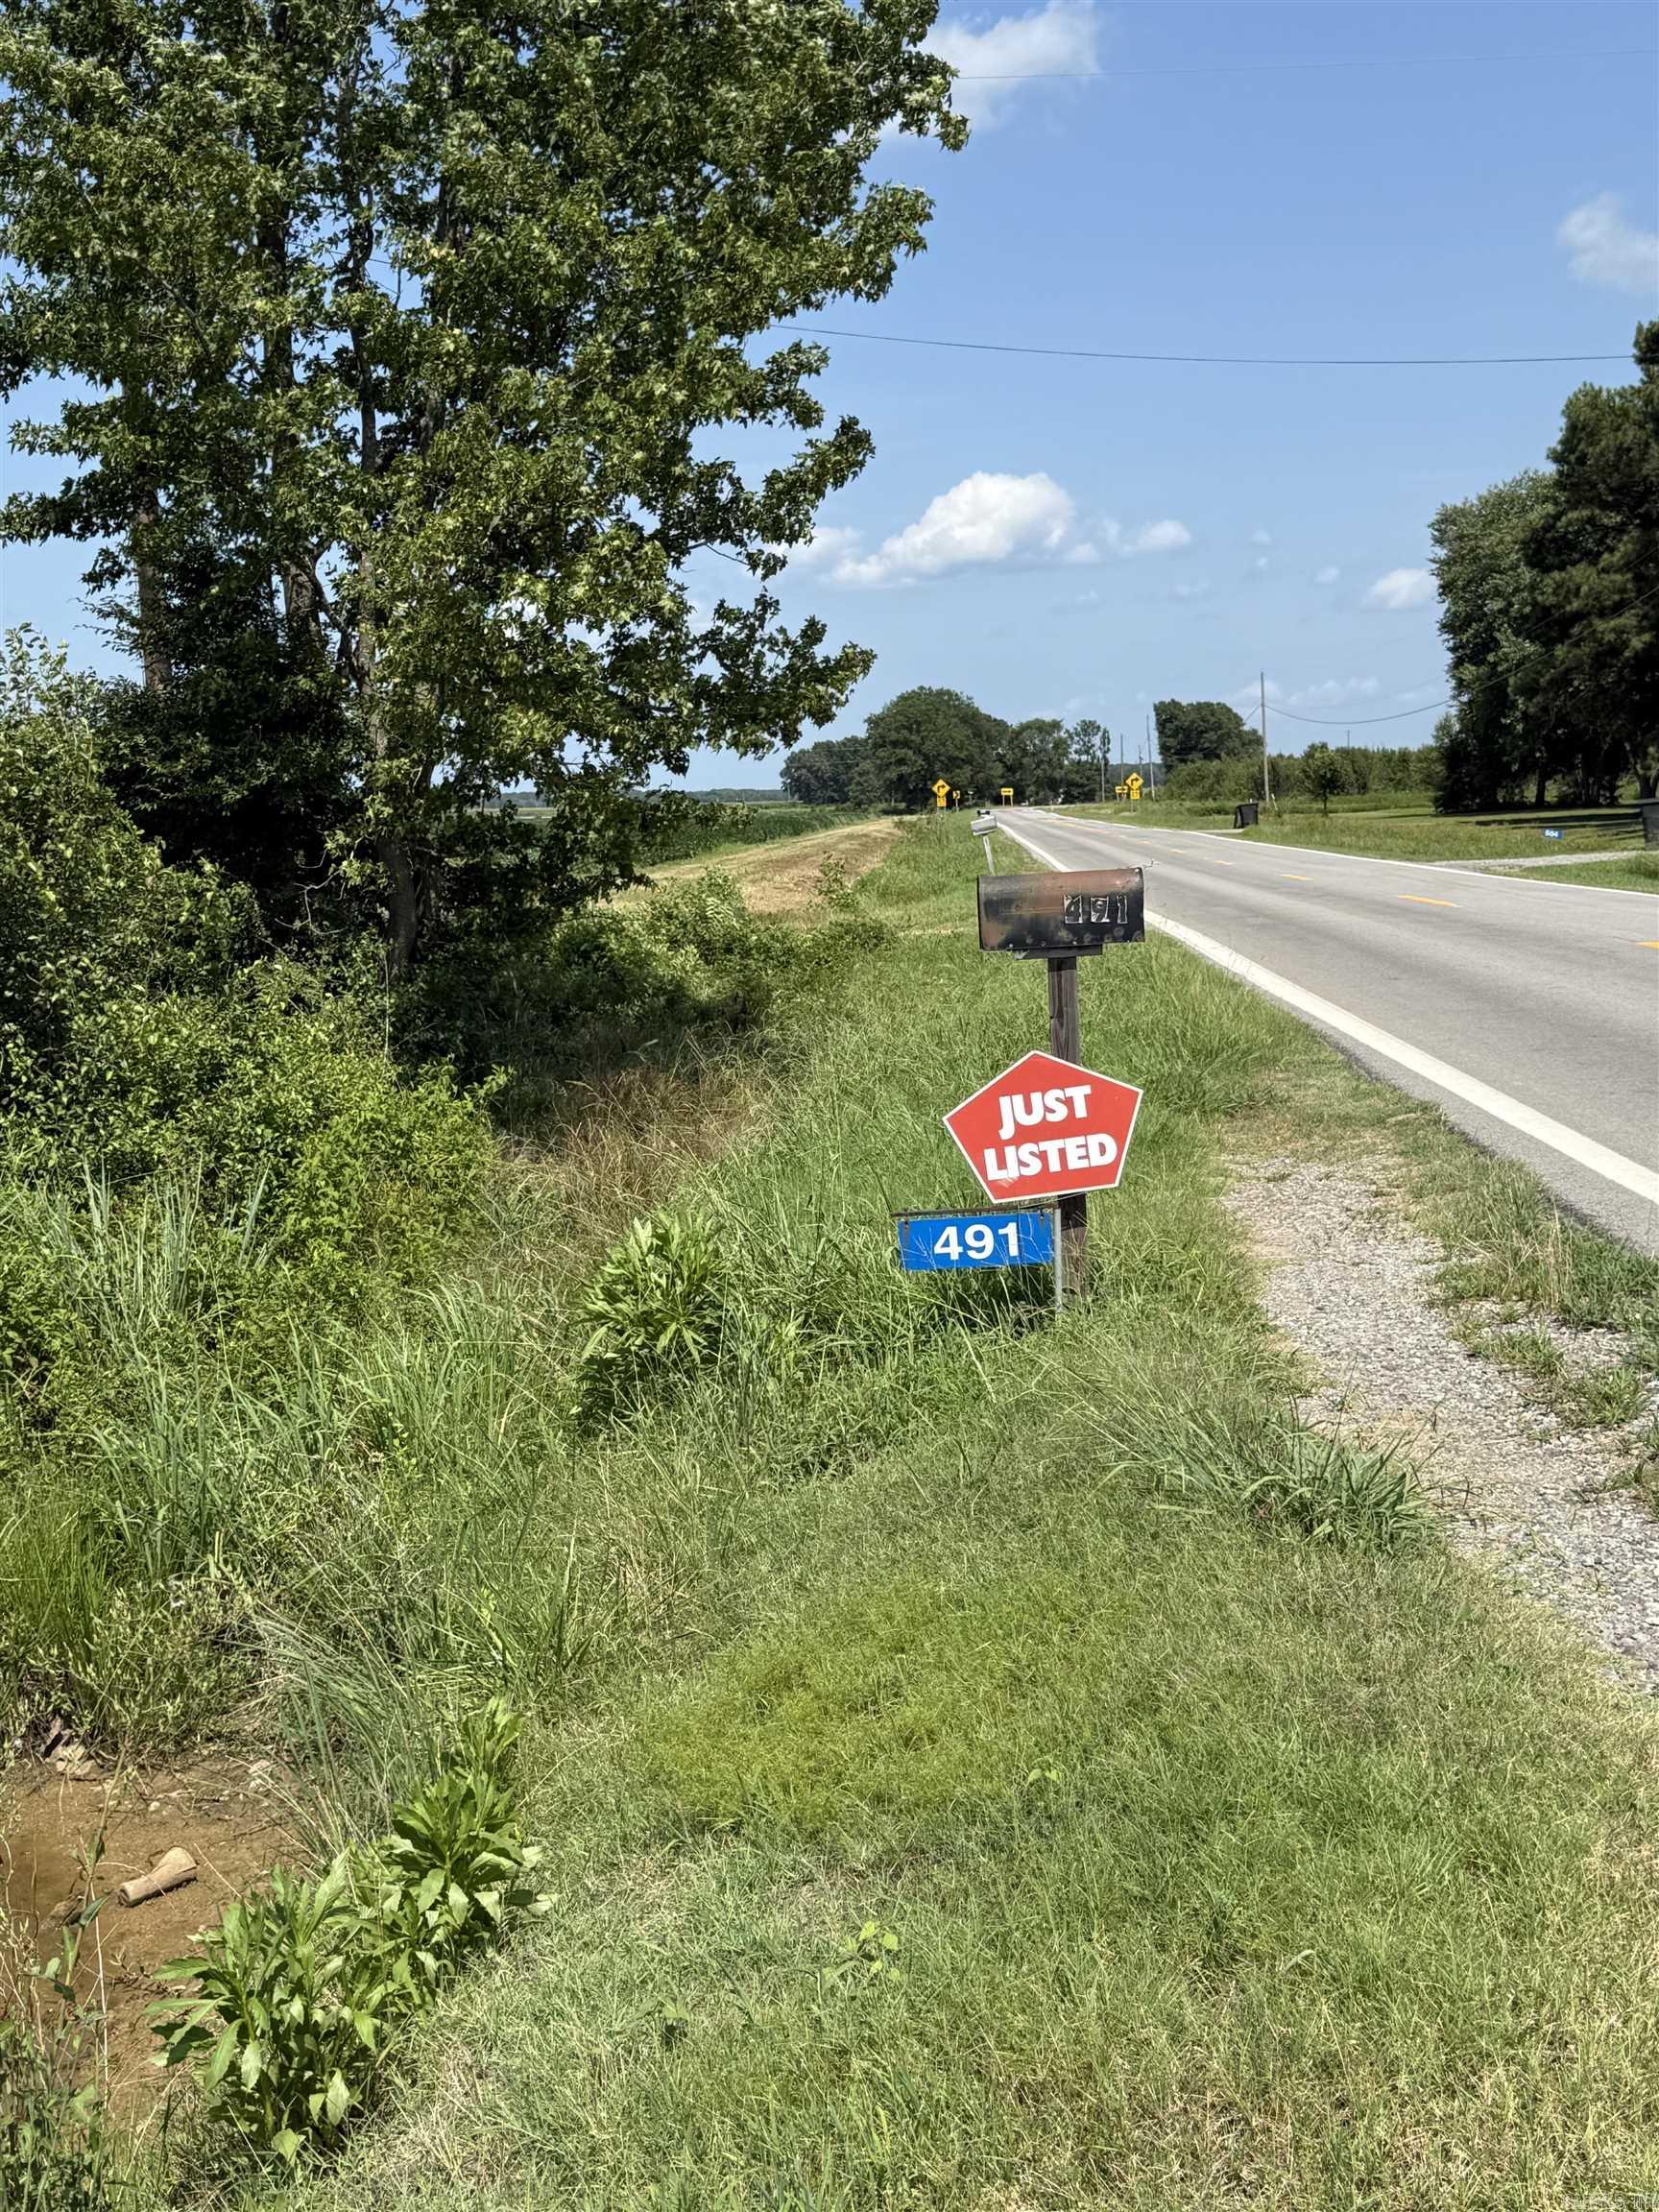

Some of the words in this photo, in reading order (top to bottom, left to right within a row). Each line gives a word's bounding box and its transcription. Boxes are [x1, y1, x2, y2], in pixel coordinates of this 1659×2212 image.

[1064, 893, 1128, 924] 491
[998, 1084, 1092, 1141] JUST
[983, 1133, 1118, 1181] LISTED
[933, 1221, 1020, 1260] 491
